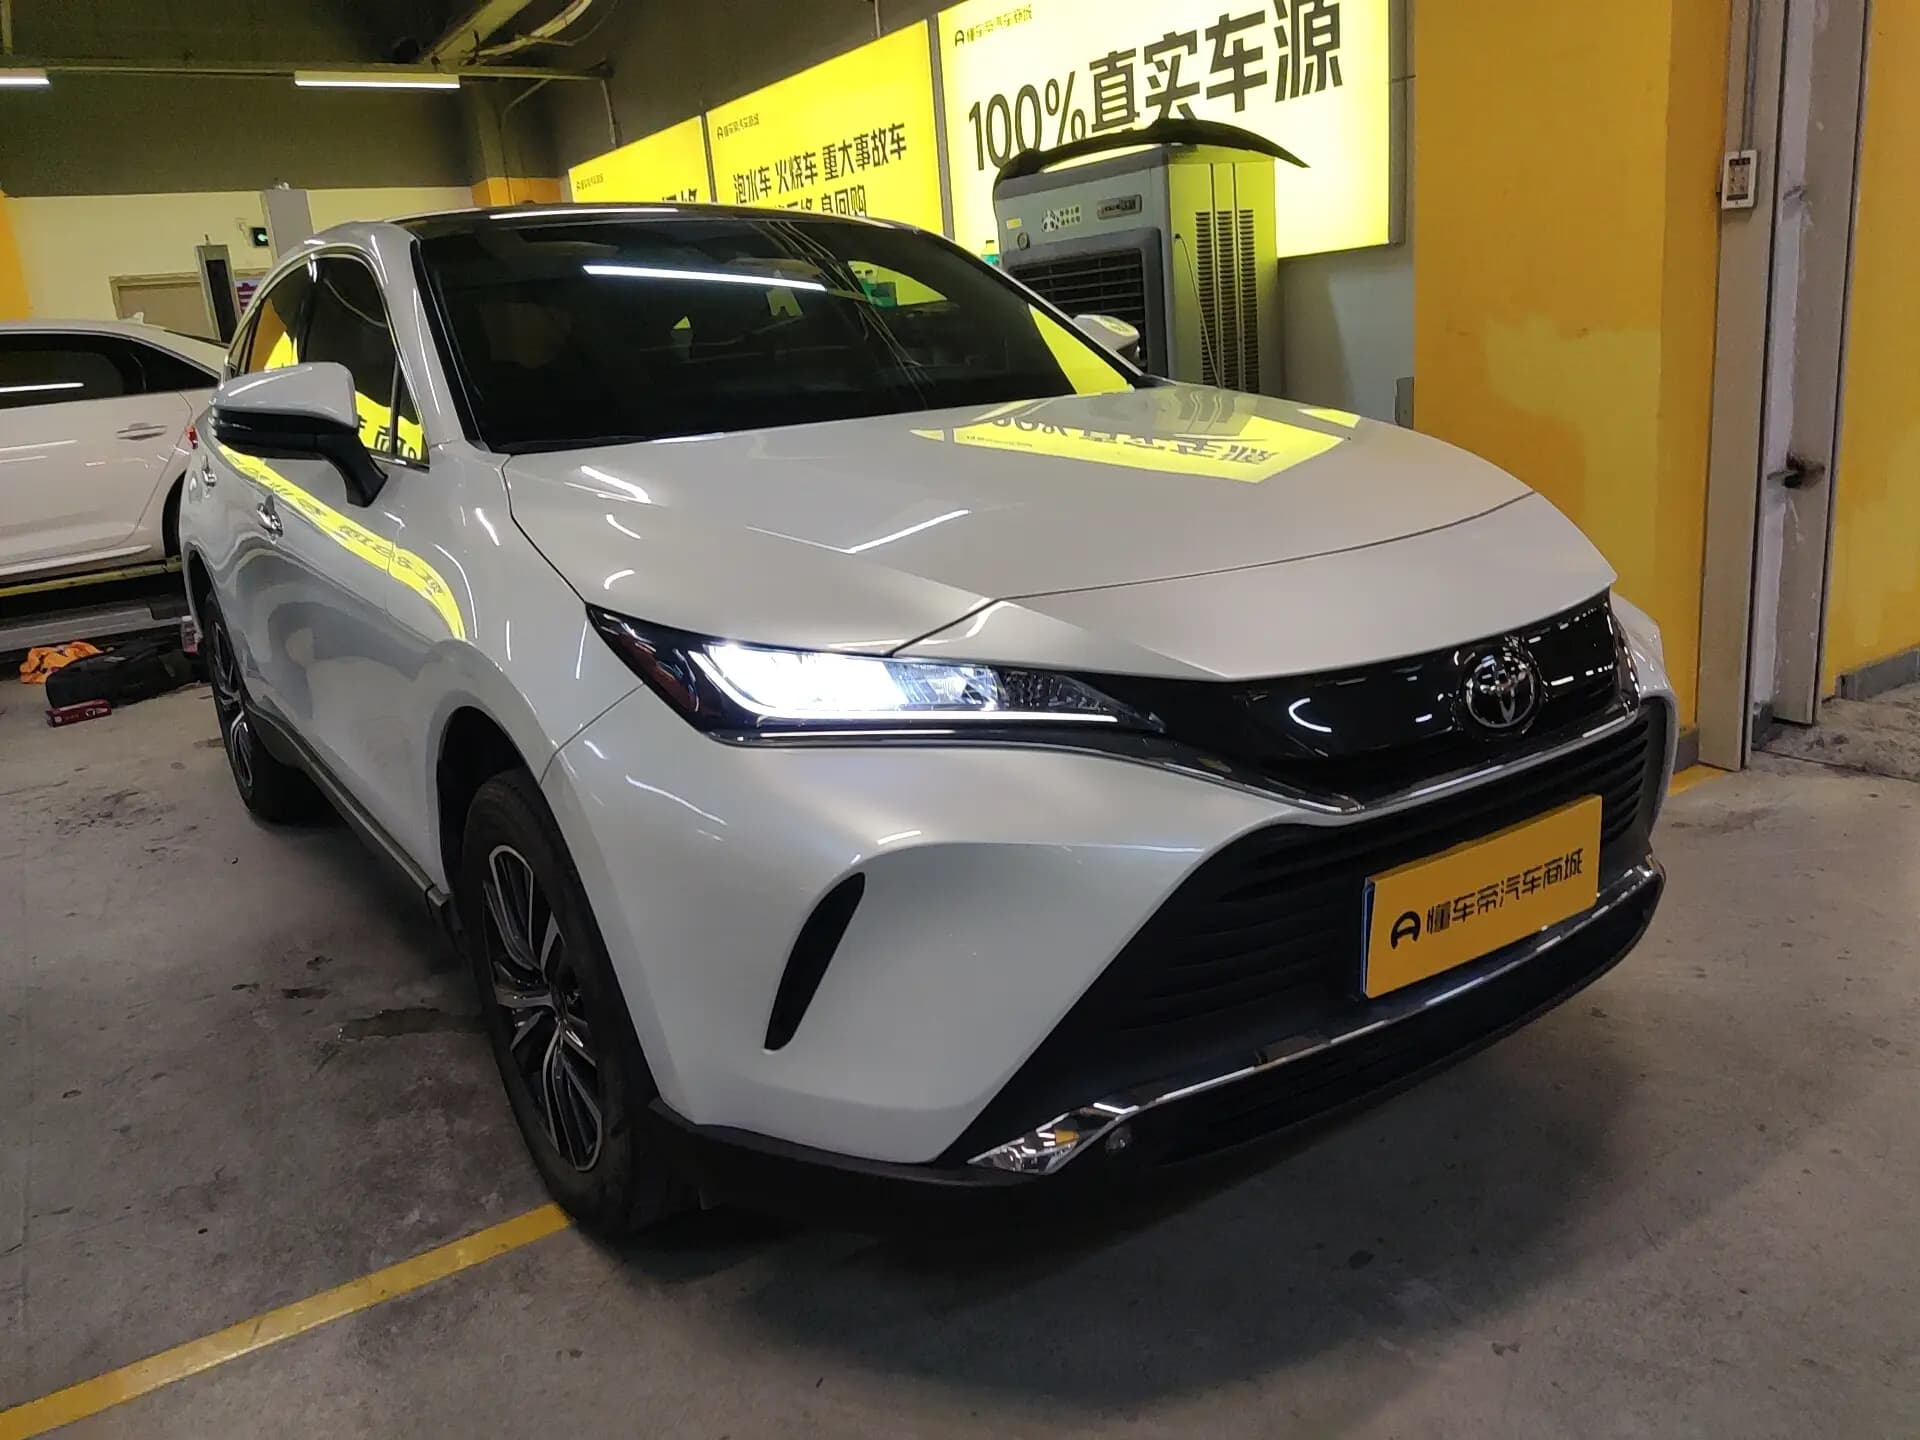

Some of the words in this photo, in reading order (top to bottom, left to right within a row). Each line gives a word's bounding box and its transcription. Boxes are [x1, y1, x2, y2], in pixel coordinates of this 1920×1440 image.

[733, 166, 772, 204] 泡水车
[775, 152, 818, 194] 火烧车
[823, 122, 907, 181] 重大事故车
[1426, 848, 1584, 935] 懂车帝汽车商城
